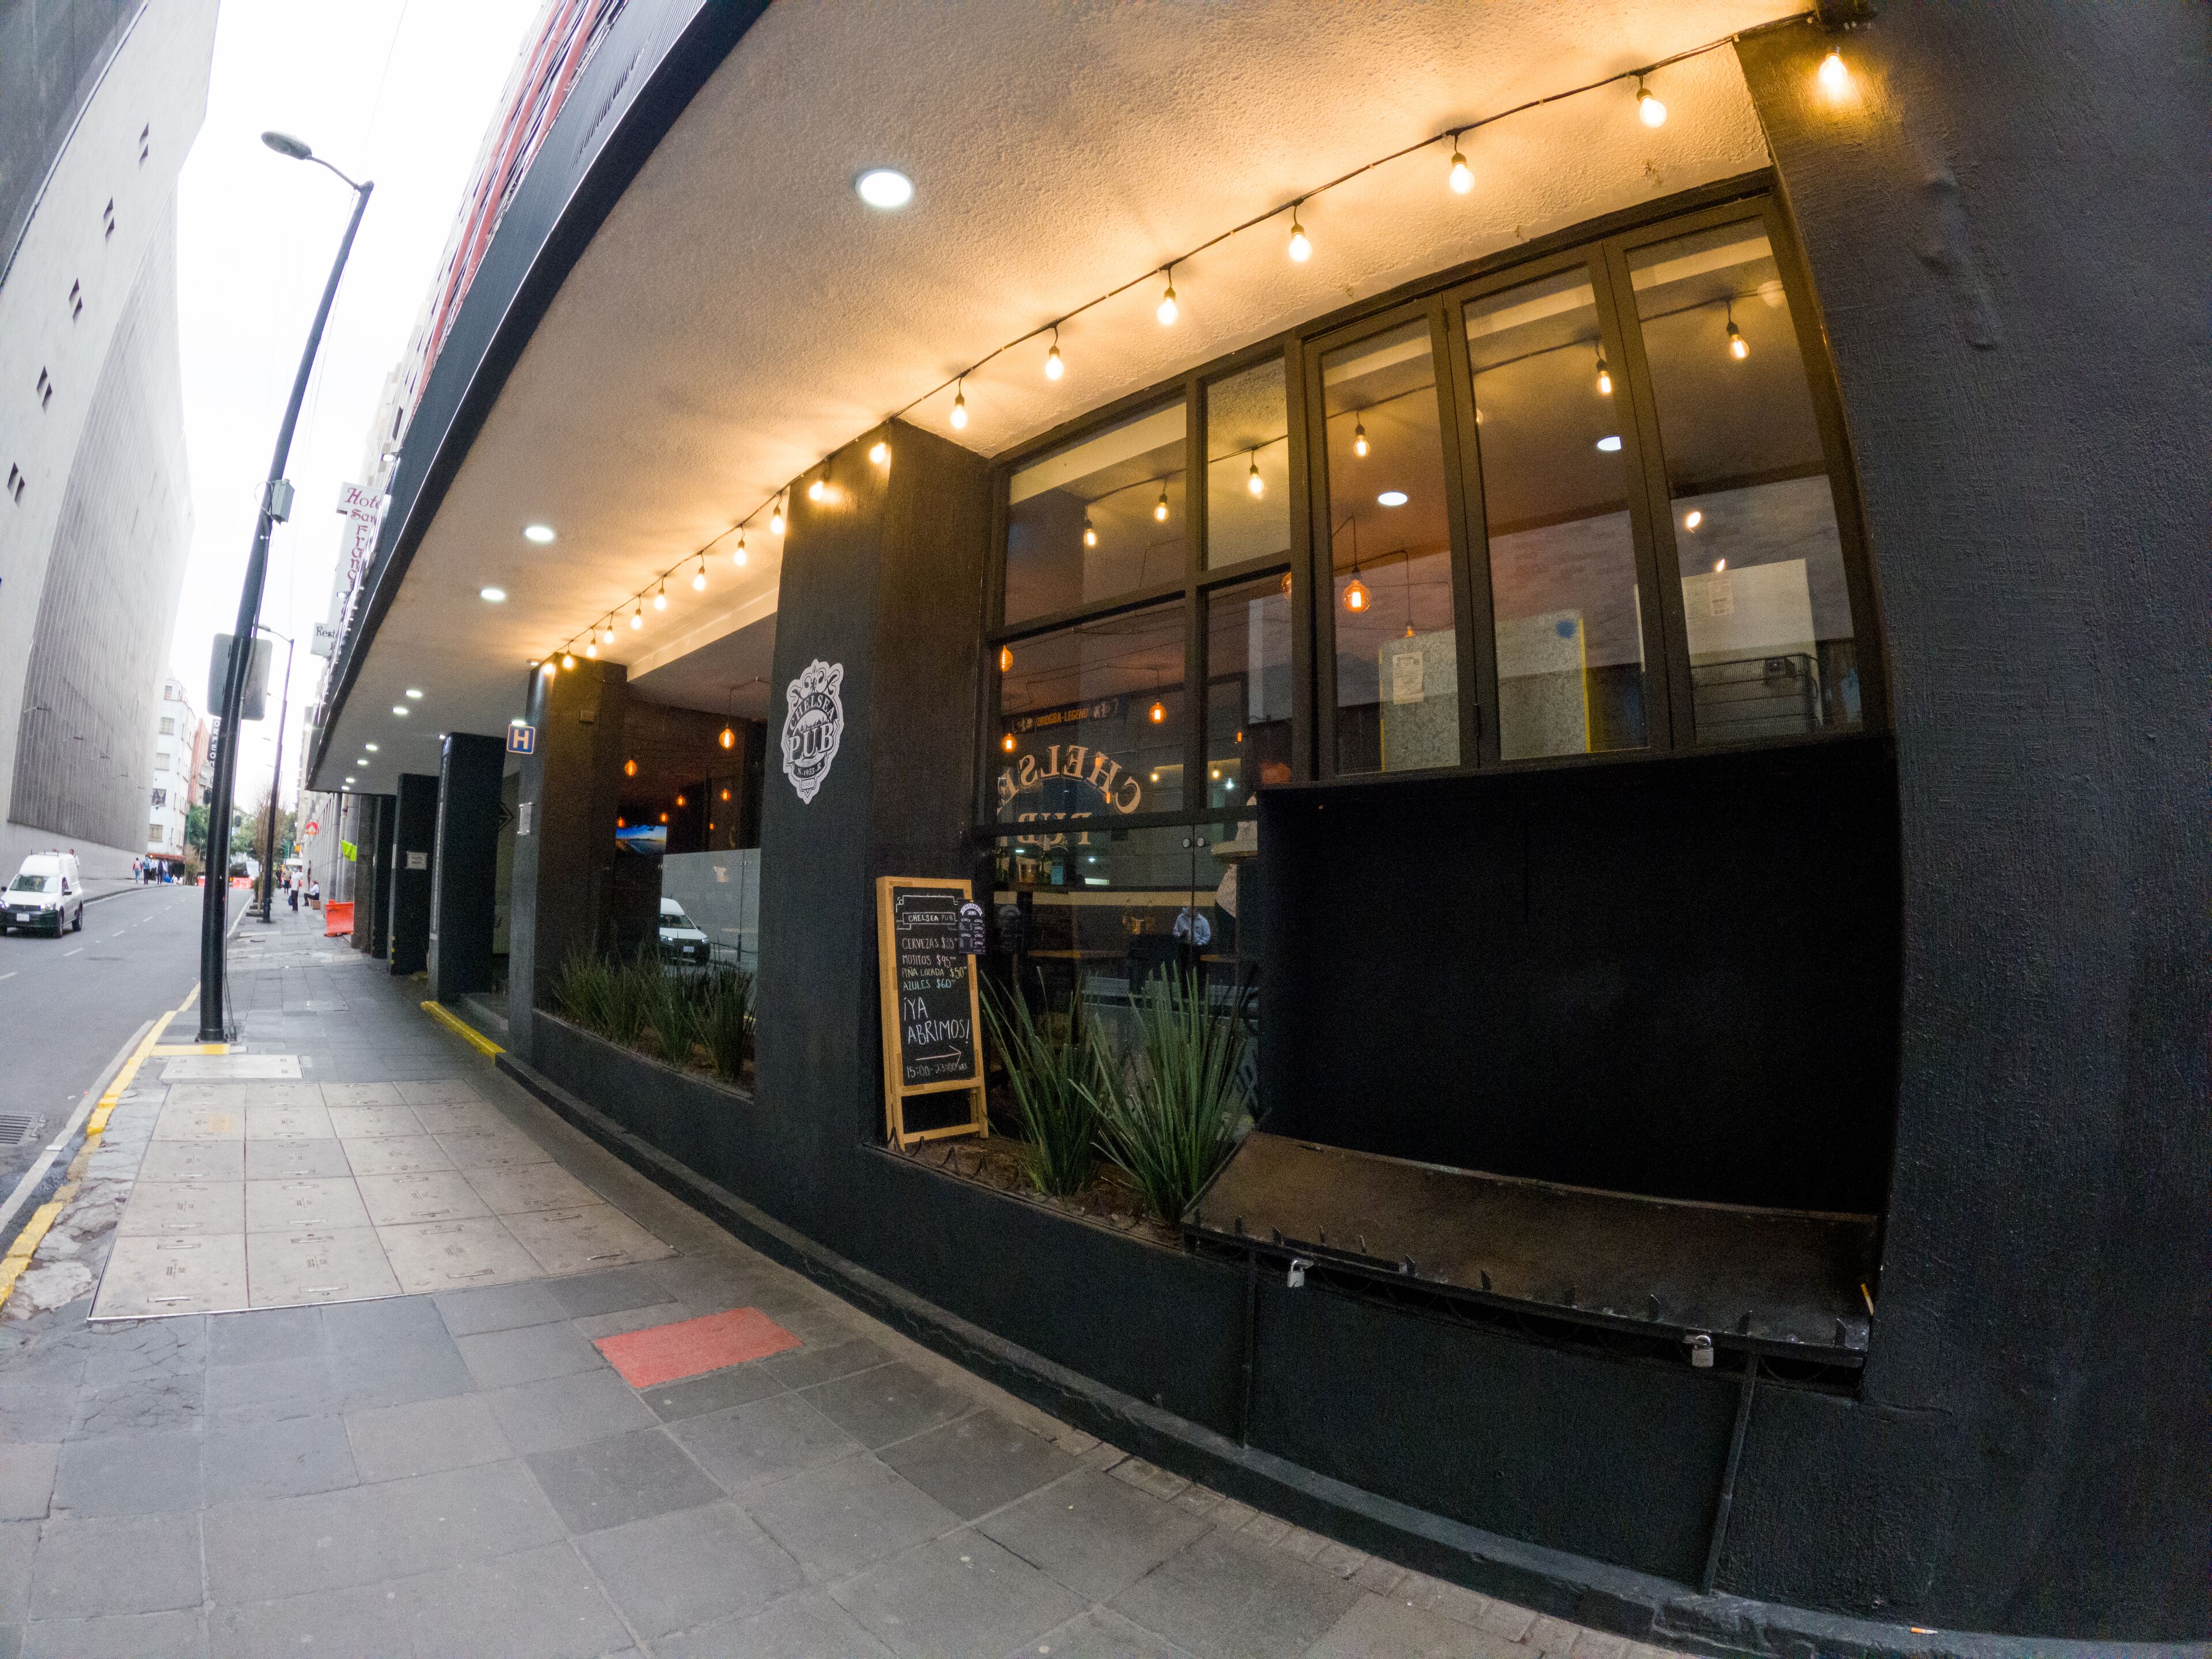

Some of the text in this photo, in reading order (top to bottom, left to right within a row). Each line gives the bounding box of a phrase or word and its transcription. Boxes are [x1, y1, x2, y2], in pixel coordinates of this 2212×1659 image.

[344, 487, 381, 510] Hote
[790, 695, 835, 731] CHELSEA
[513, 729, 529, 749] H
[787, 722, 834, 764] PUB
[908, 914, 939, 922] CHELSEA
[902, 938, 939, 949] CERVEZAS
[902, 955, 931, 965] MOJITOS
[902, 967, 918, 978] PIÑA
[920, 967, 945, 976] COLADA
[903, 979, 931, 991] AZULES
[908, 1019, 969, 1045] ABRIMOS!
